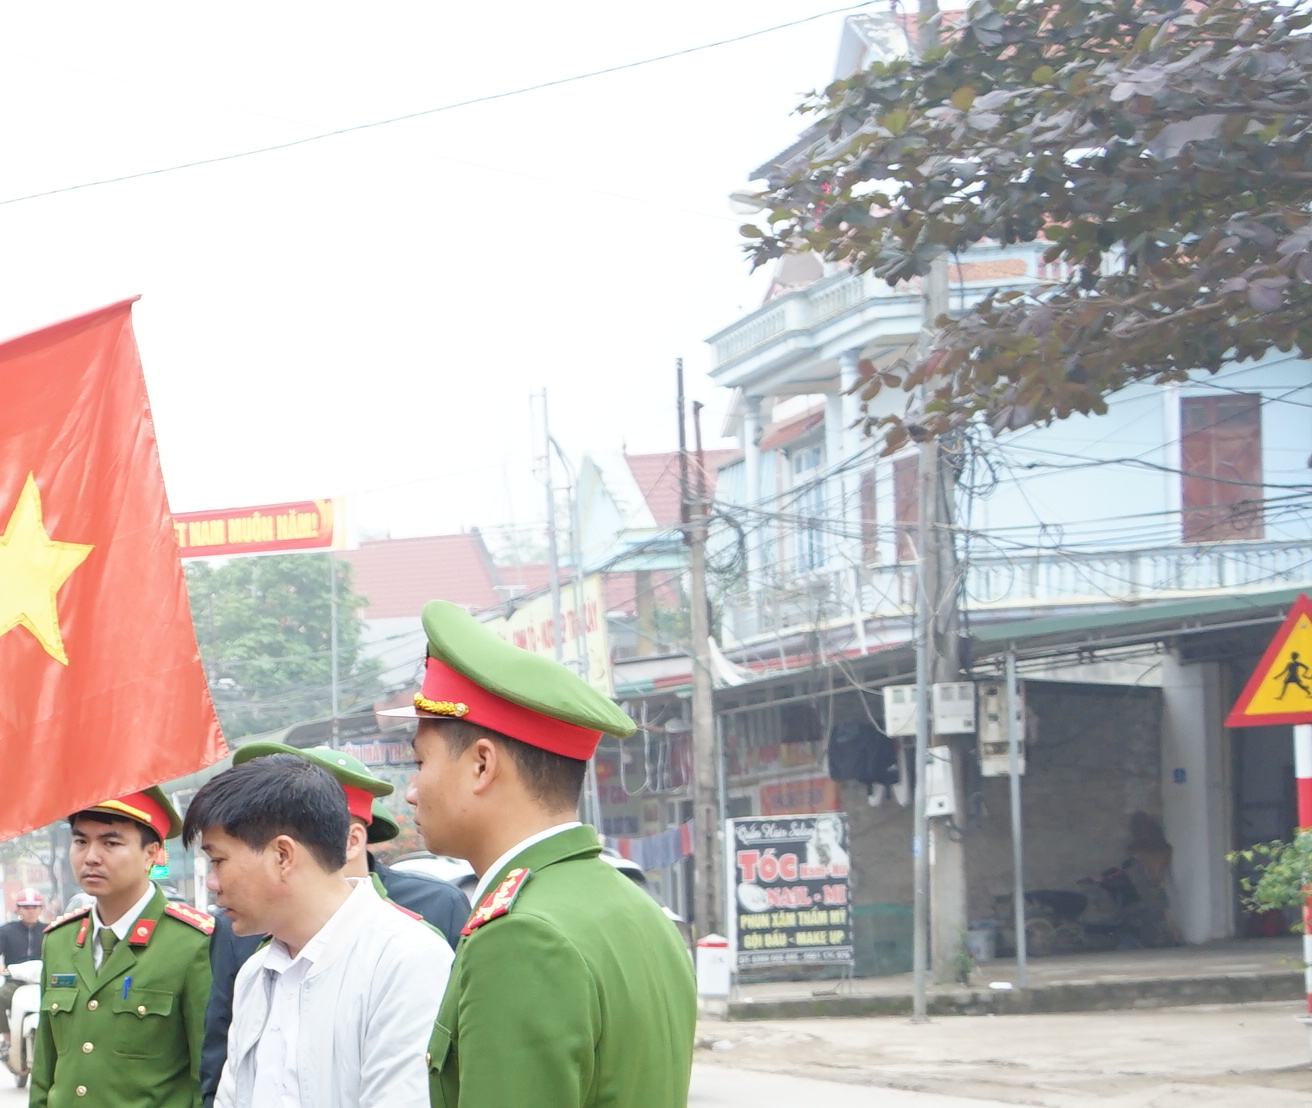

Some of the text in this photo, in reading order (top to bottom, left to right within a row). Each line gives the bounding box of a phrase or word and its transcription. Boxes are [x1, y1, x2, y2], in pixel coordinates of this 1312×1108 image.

[189, 519, 226, 547] NAM
[228, 511, 275, 544] MUÔN
[276, 508, 319, 540] NĂM!
[737, 848, 799, 883] TÓC
